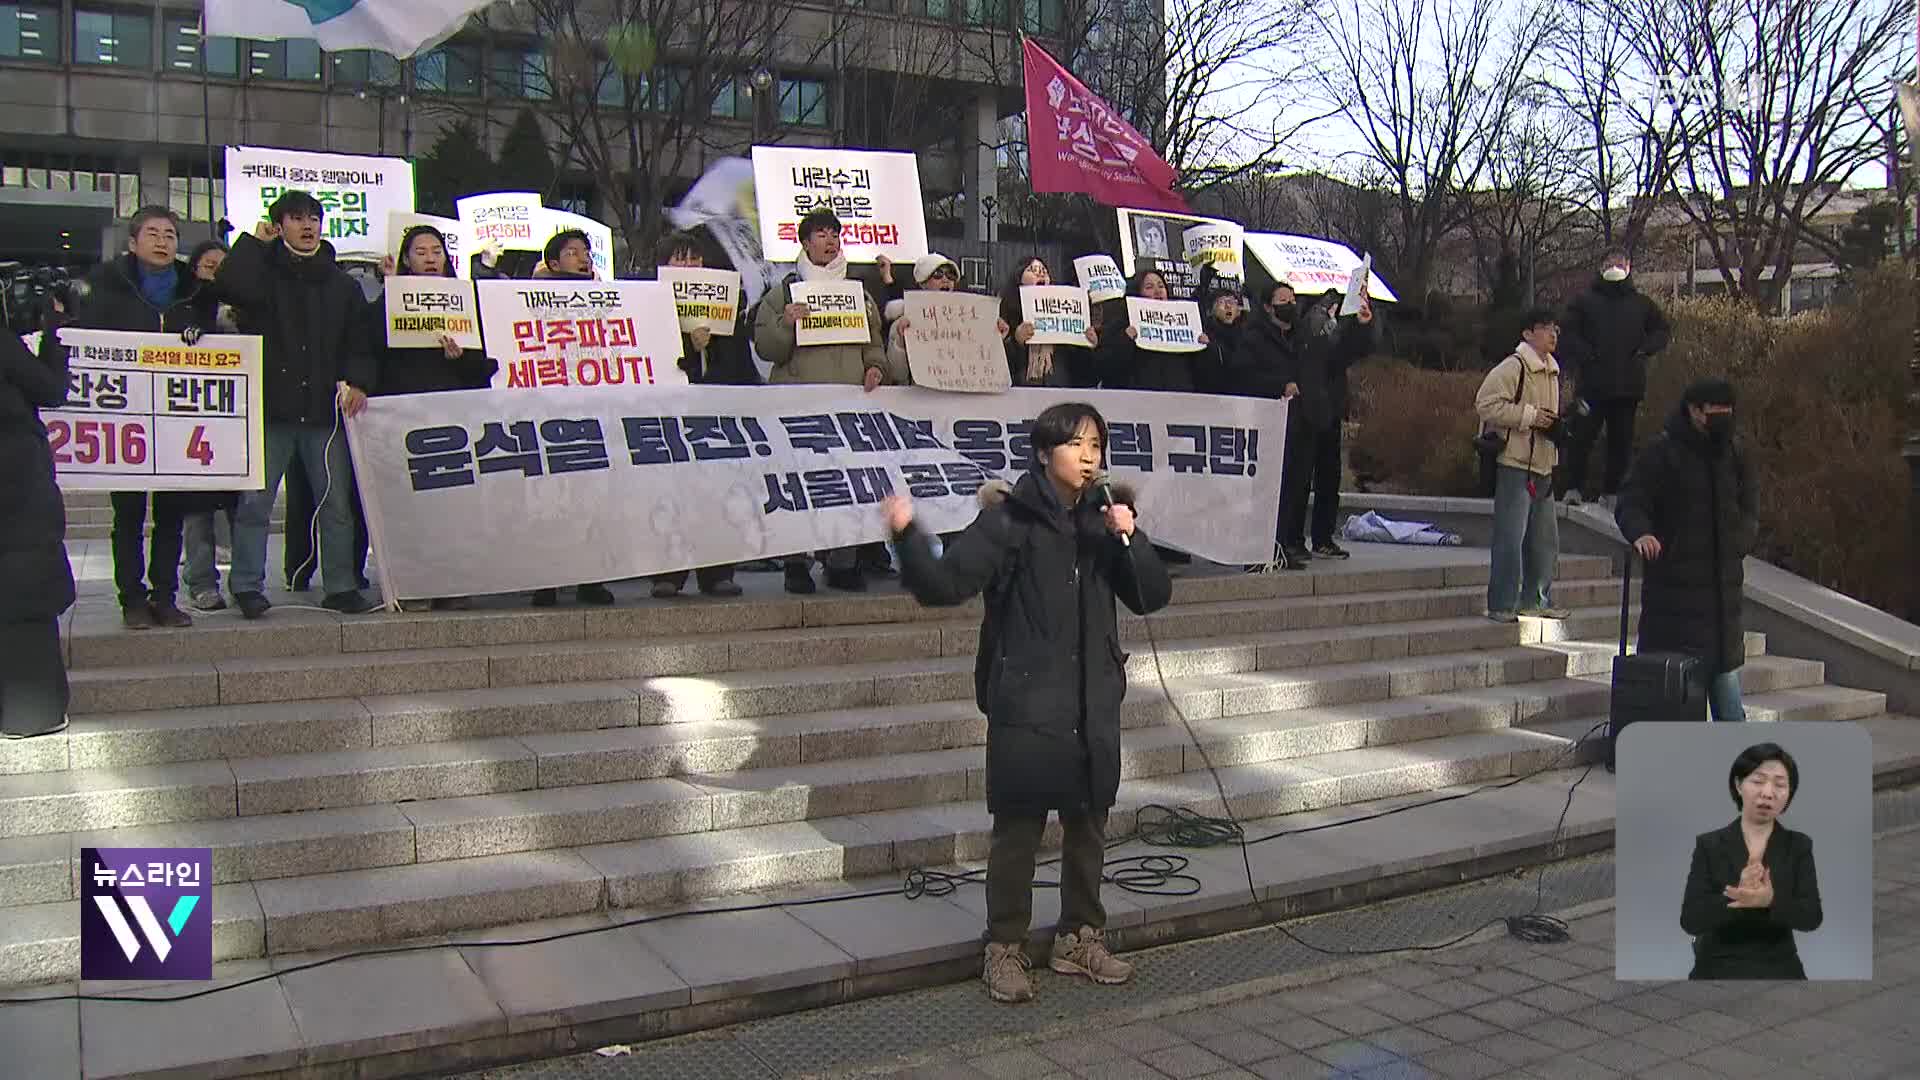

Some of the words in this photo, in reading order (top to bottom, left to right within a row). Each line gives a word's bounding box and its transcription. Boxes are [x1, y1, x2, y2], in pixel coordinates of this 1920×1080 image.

[792, 166, 871, 190] 내란수괴
[261, 186, 368, 213] 민주의
[793, 194, 873, 219] 윤석열은
[841, 223, 899, 246] 진하라
[402, 292, 464, 312] 민주주의
[517, 290, 587, 308] 가짜뉴스
[587, 290, 622, 308] 유포
[672, 281, 729, 302] 민주주의
[676, 303, 710, 319] 괴세력
[807, 294, 857, 313] 민주주의
[1034, 297, 1083, 316] 내란수괴
[394, 317, 446, 332] 파괴세력
[1139, 309, 1190, 326] 내란수괴
[512, 317, 638, 353] 민주파괴
[141, 349, 181, 366] 윤석열
[184, 350, 212, 366] 퇴진
[214, 351, 241, 367] 요구
[507, 358, 569, 388] 세력
[576, 356, 655, 386] OUT!
[167, 376, 236, 415] 반대
[48, 419, 147, 466] 2516
[185, 424, 215, 466] 4
[404, 416, 610, 492] 윤석열
[620, 415, 773, 467] 퇴진!
[952, 418, 1038, 473] 옹호
[1106, 420, 1154, 473] 력
[1165, 422, 1260, 477] 규탄!
[763, 465, 896, 515] 서울대
